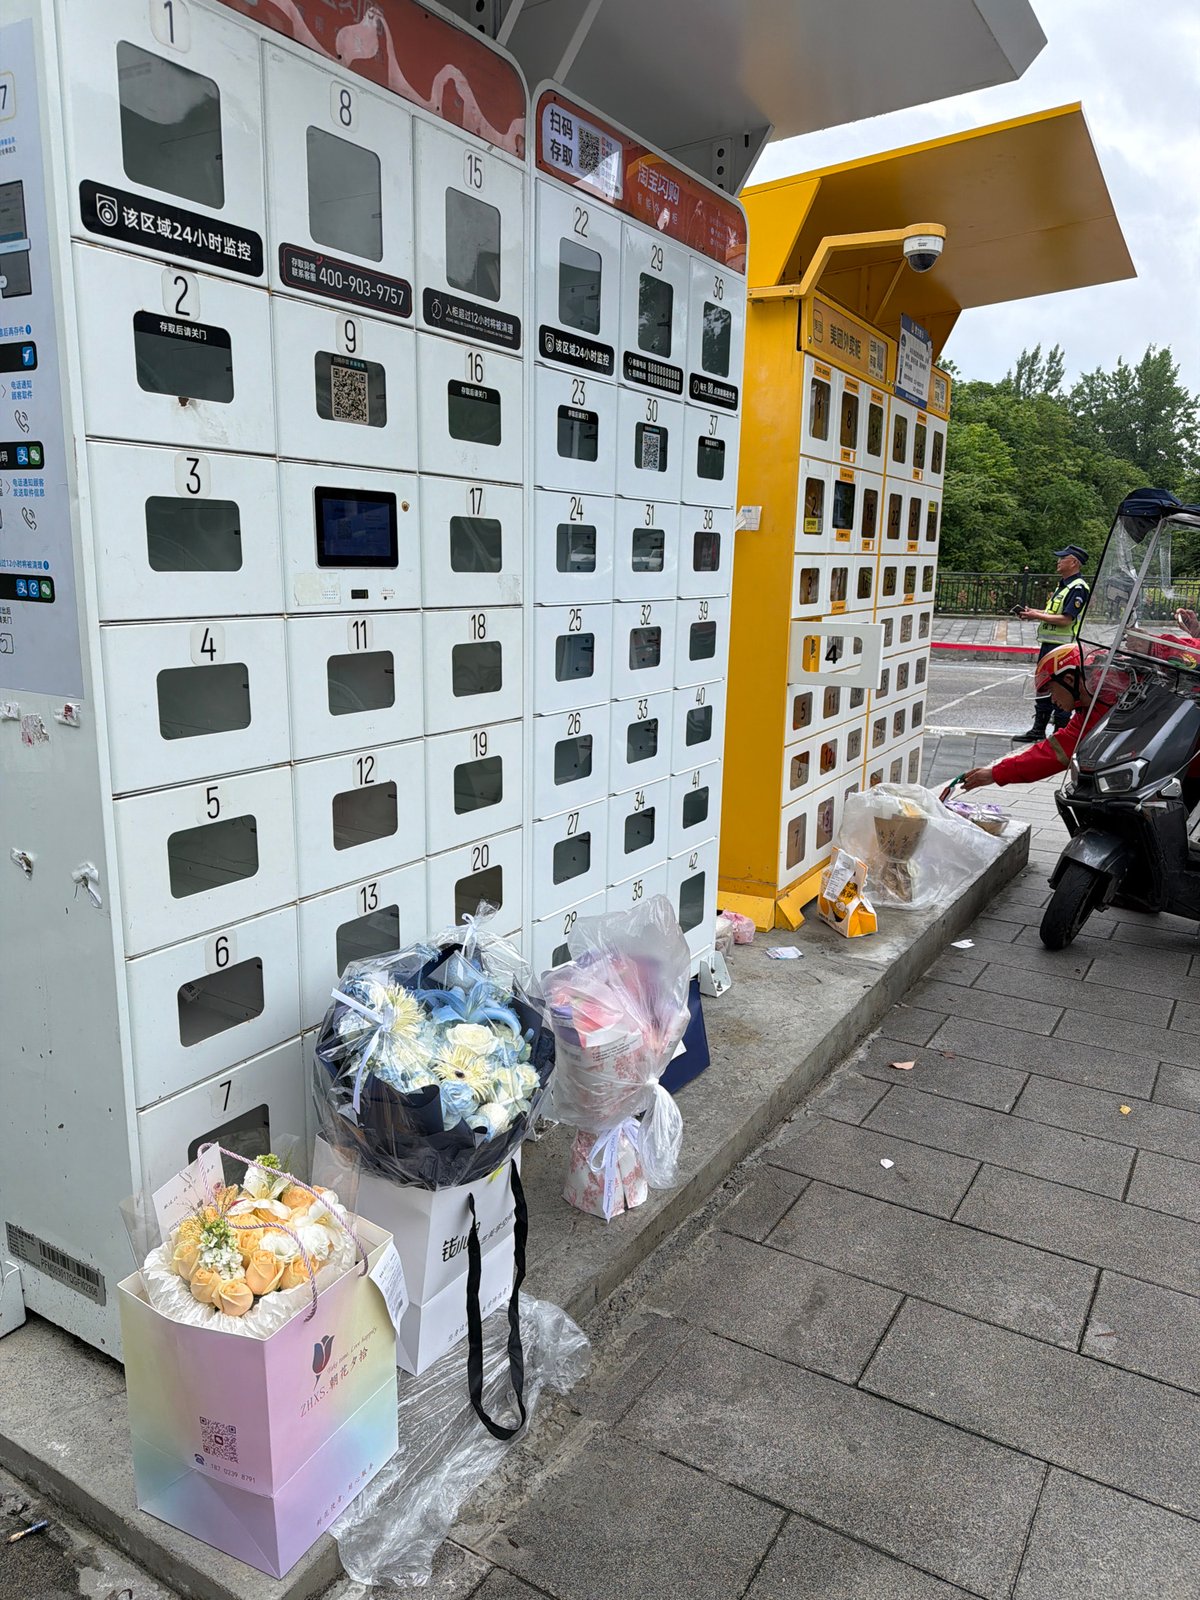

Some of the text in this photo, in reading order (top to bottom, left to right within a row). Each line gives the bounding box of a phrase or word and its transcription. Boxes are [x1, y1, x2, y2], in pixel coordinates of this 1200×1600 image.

[164, 1, 174, 44] 1
[340, 90, 352, 126] 8
[550, 108, 573, 140] 扫码
[550, 138, 573, 168] 存取
[467, 154, 483, 188] 15
[638, 161, 679, 205] 淘宝闪购
[122, 206, 251, 262] 该区域24小时监控
[574, 207, 589, 238] 22
[291, 257, 316, 273] 存取异常
[651, 245, 664, 272] 29
[174, 276, 190, 316] 2
[319, 267, 404, 306] 400-903-9757
[713, 276, 724, 301] 36
[160, 321, 207, 341] 存取后请关门
[345, 320, 356, 353] 9
[830, 324, 861, 360] 美团外卖柜
[555, 339, 609, 366] 该区域24小时监控
[468, 352, 483, 383] 16
[11, 380, 32, 389] 电话通知
[12, 390, 32, 400] 顾客取件
[572, 379, 585, 406] 23
[646, 399, 658, 423] 30
[709, 415, 718, 436] 37
[13, 478, 44, 487] 电话通知顾客
[186, 457, 200, 494] 3
[13, 488, 45, 497] 发送取件信息
[470, 487, 483, 515] 17
[570, 497, 583, 521] 24
[645, 504, 655, 526] 31
[703, 510, 713, 529] 38
[569, 609, 582, 632] 25
[640, 605, 651, 625] 32
[699, 601, 708, 620] 39
[352, 620, 367, 649] 11
[471, 613, 486, 640] 18
[200, 628, 216, 661] 4
[825, 645, 839, 664] 4
[696, 687, 706, 705] 40
[637, 699, 648, 720] 33
[801, 702, 806, 720] 5
[568, 713, 581, 735] 26
[473, 731, 488, 757] 19
[357, 756, 374, 785] 12
[692, 771, 700, 788] 41
[206, 786, 220, 819] 5
[634, 791, 645, 811] 34
[567, 813, 579, 835] 27
[795, 829, 799, 847] 7
[472, 844, 489, 871] 20
[689, 853, 698, 870] 42
[360, 883, 378, 912] 13
[632, 880, 643, 901] 35
[215, 936, 229, 967] 6
[220, 1080, 232, 1111] 7
[211, 1463, 221, 1472] 187
[241, 1474, 256, 1483] 8791
